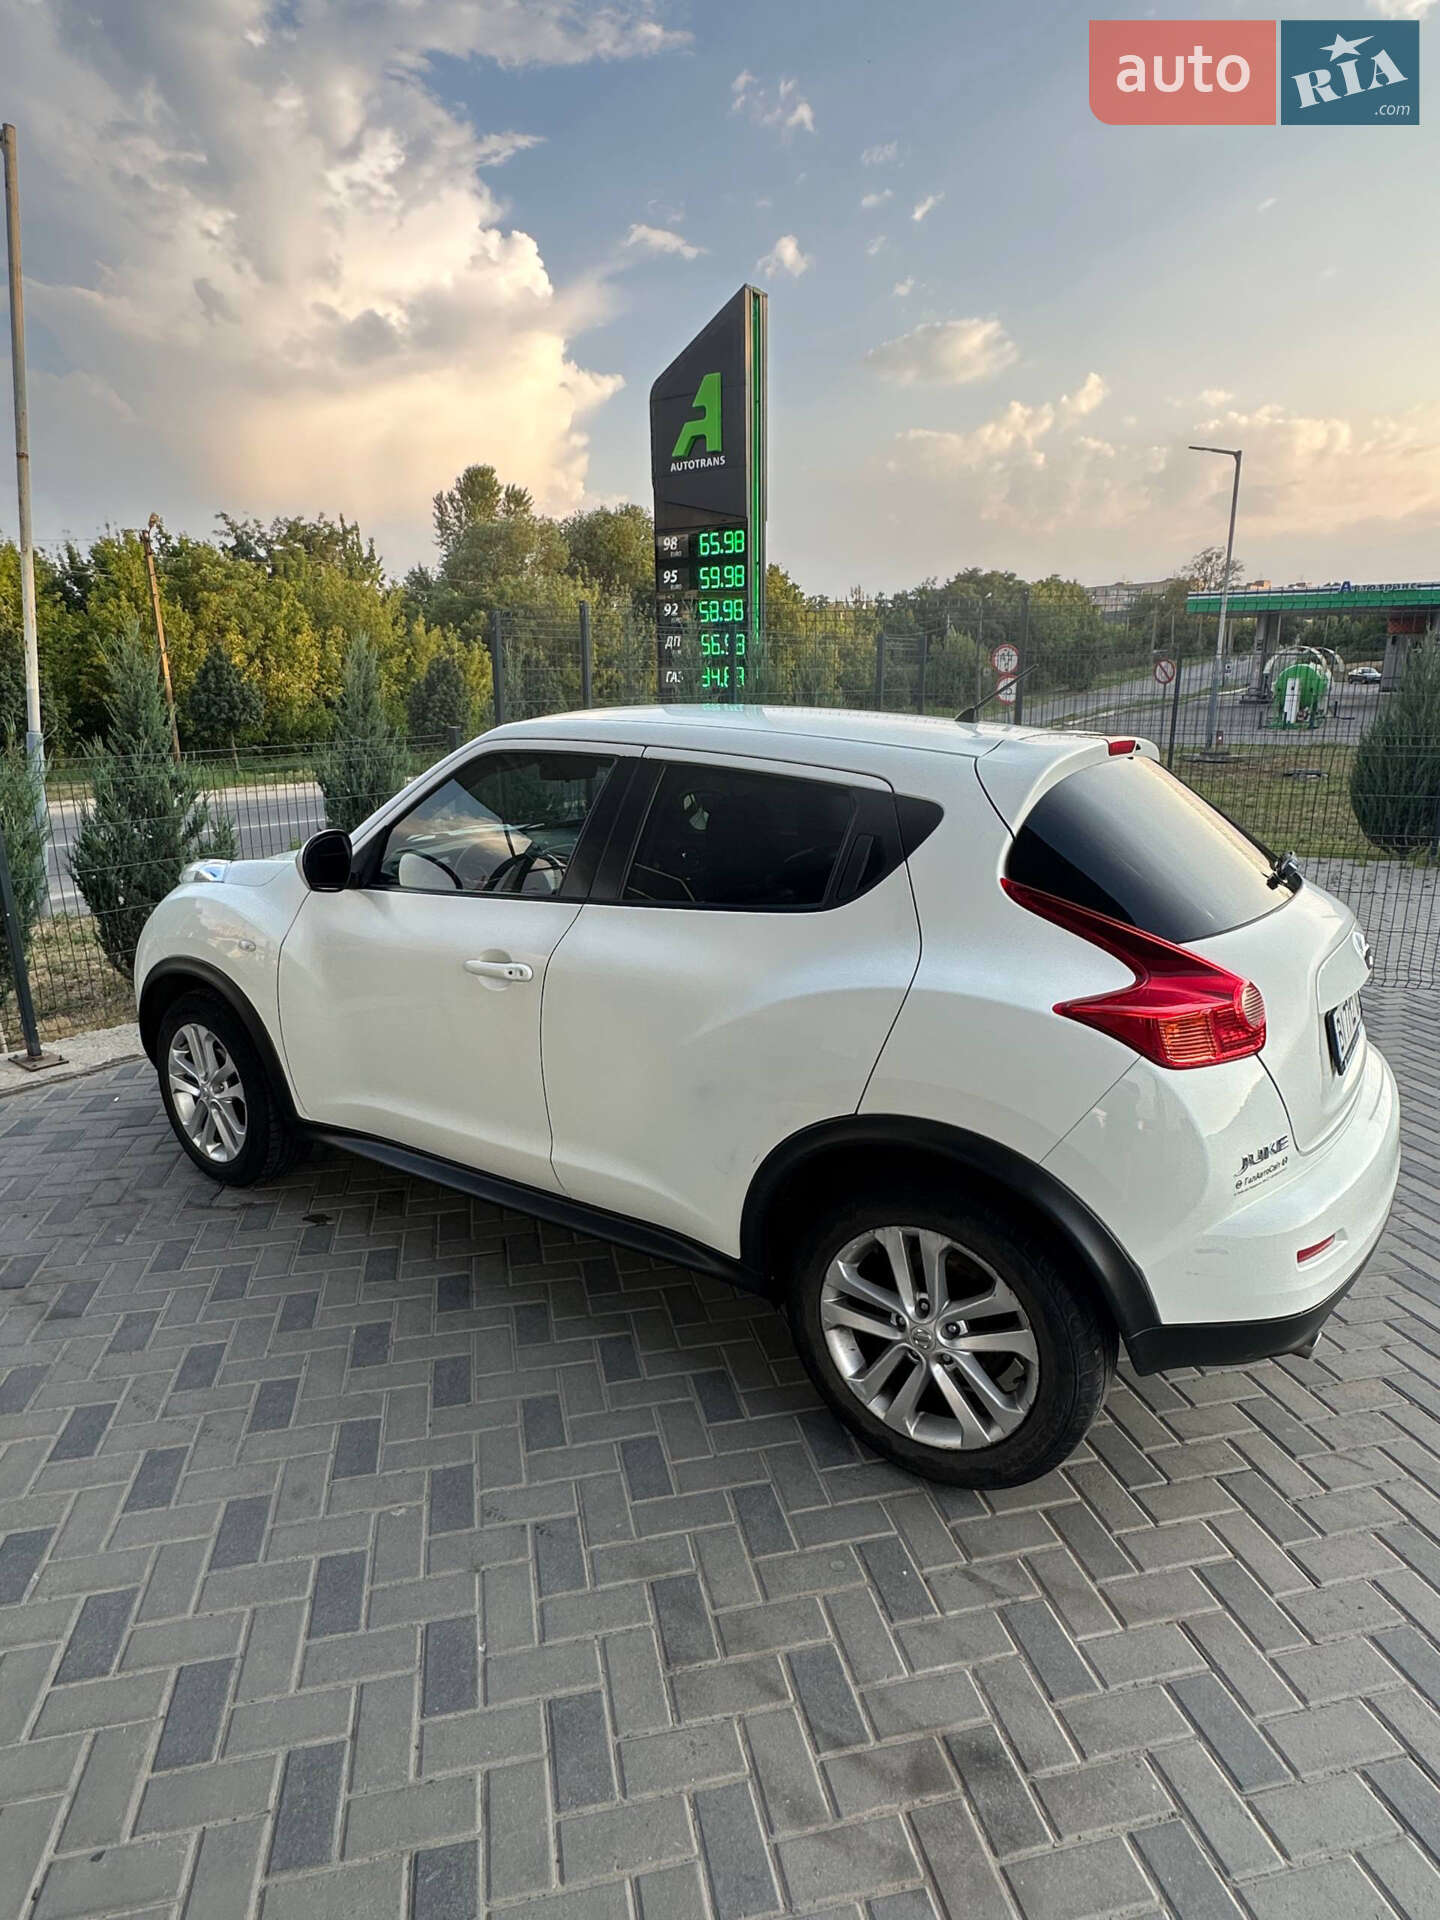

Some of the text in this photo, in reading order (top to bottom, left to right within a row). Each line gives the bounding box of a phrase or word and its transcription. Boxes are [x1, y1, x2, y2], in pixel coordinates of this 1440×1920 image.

[670, 456, 726, 472] AUTOTRANS
[663, 530, 745, 555] 98 65.98
[663, 565, 745, 589] 95 59.98
[664, 599, 744, 622] 92 58.98
[664, 635, 680, 650] ДП
[1234, 1135, 1289, 1177] JUKE
